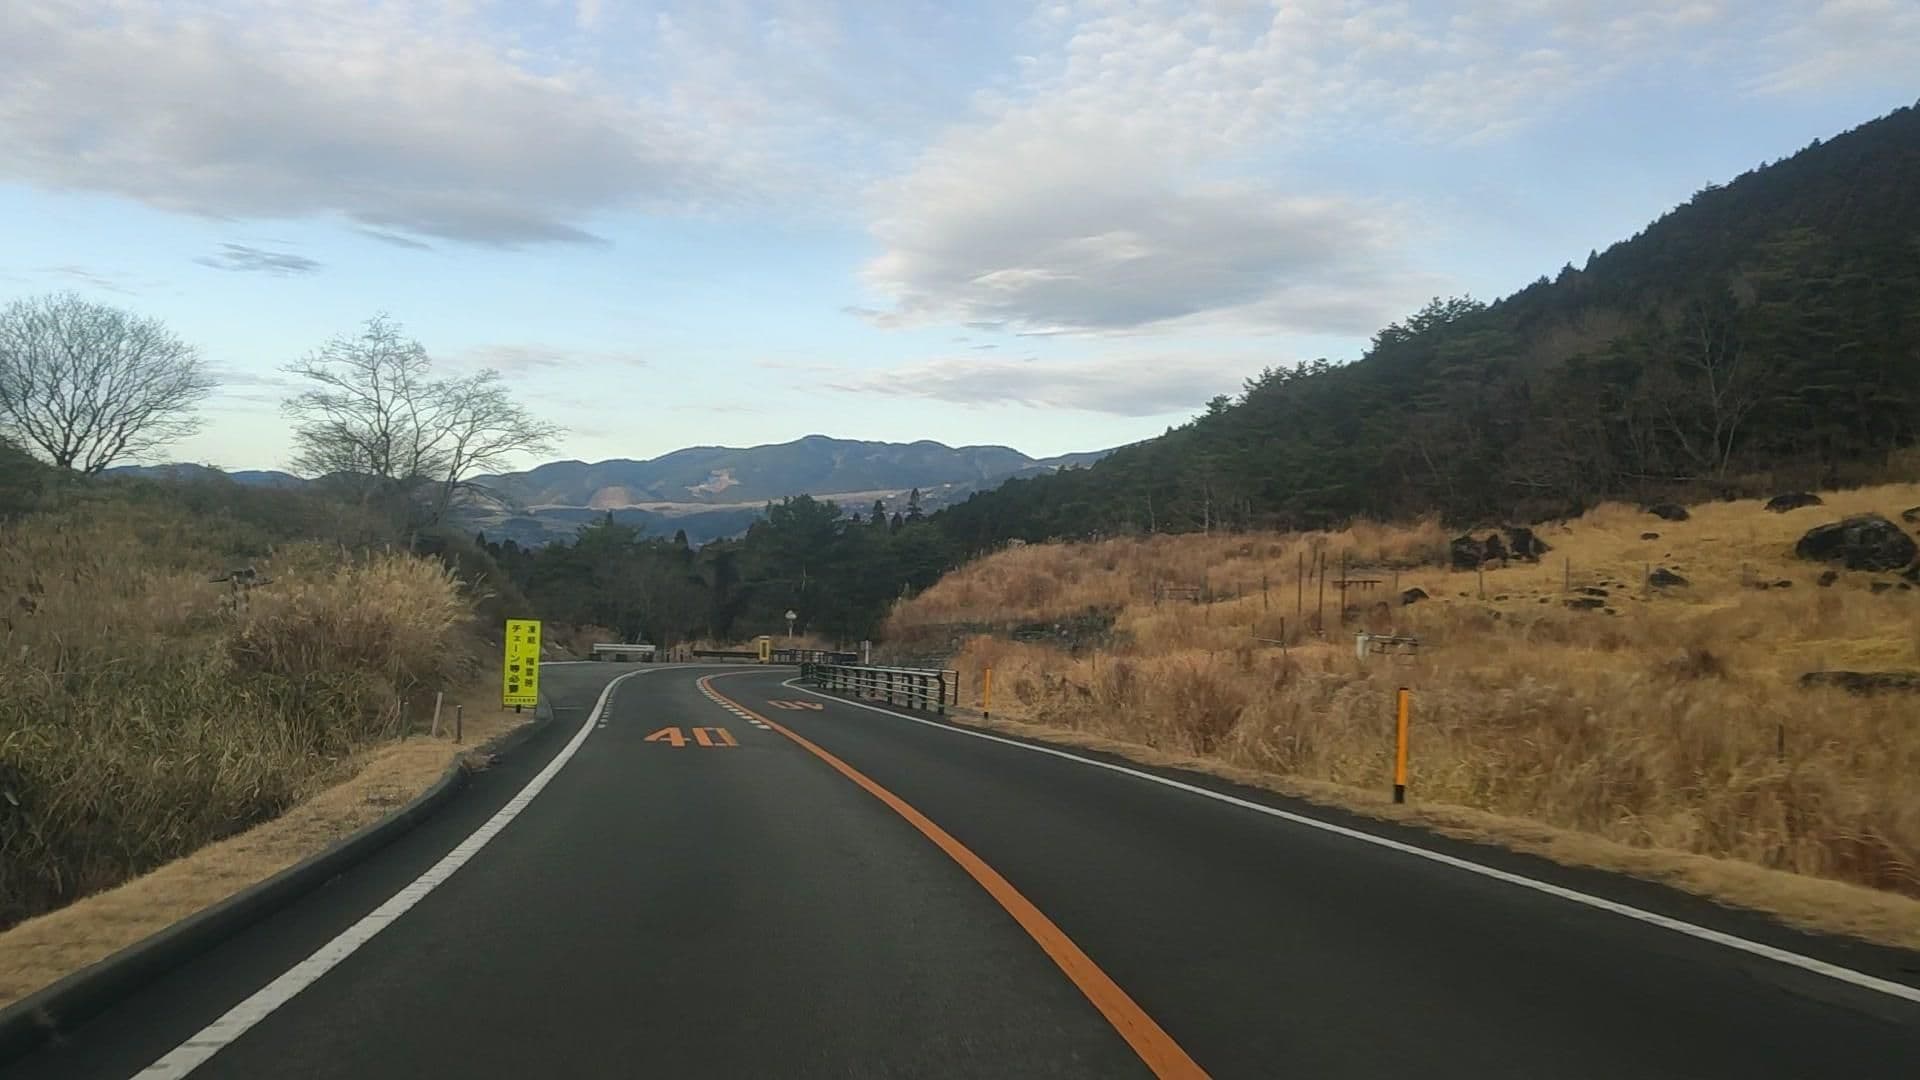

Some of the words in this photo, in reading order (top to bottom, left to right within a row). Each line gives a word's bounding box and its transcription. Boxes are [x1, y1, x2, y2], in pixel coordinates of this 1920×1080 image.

[508, 624, 522, 694] チェーン等必要
[643, 726, 739, 747] 40
